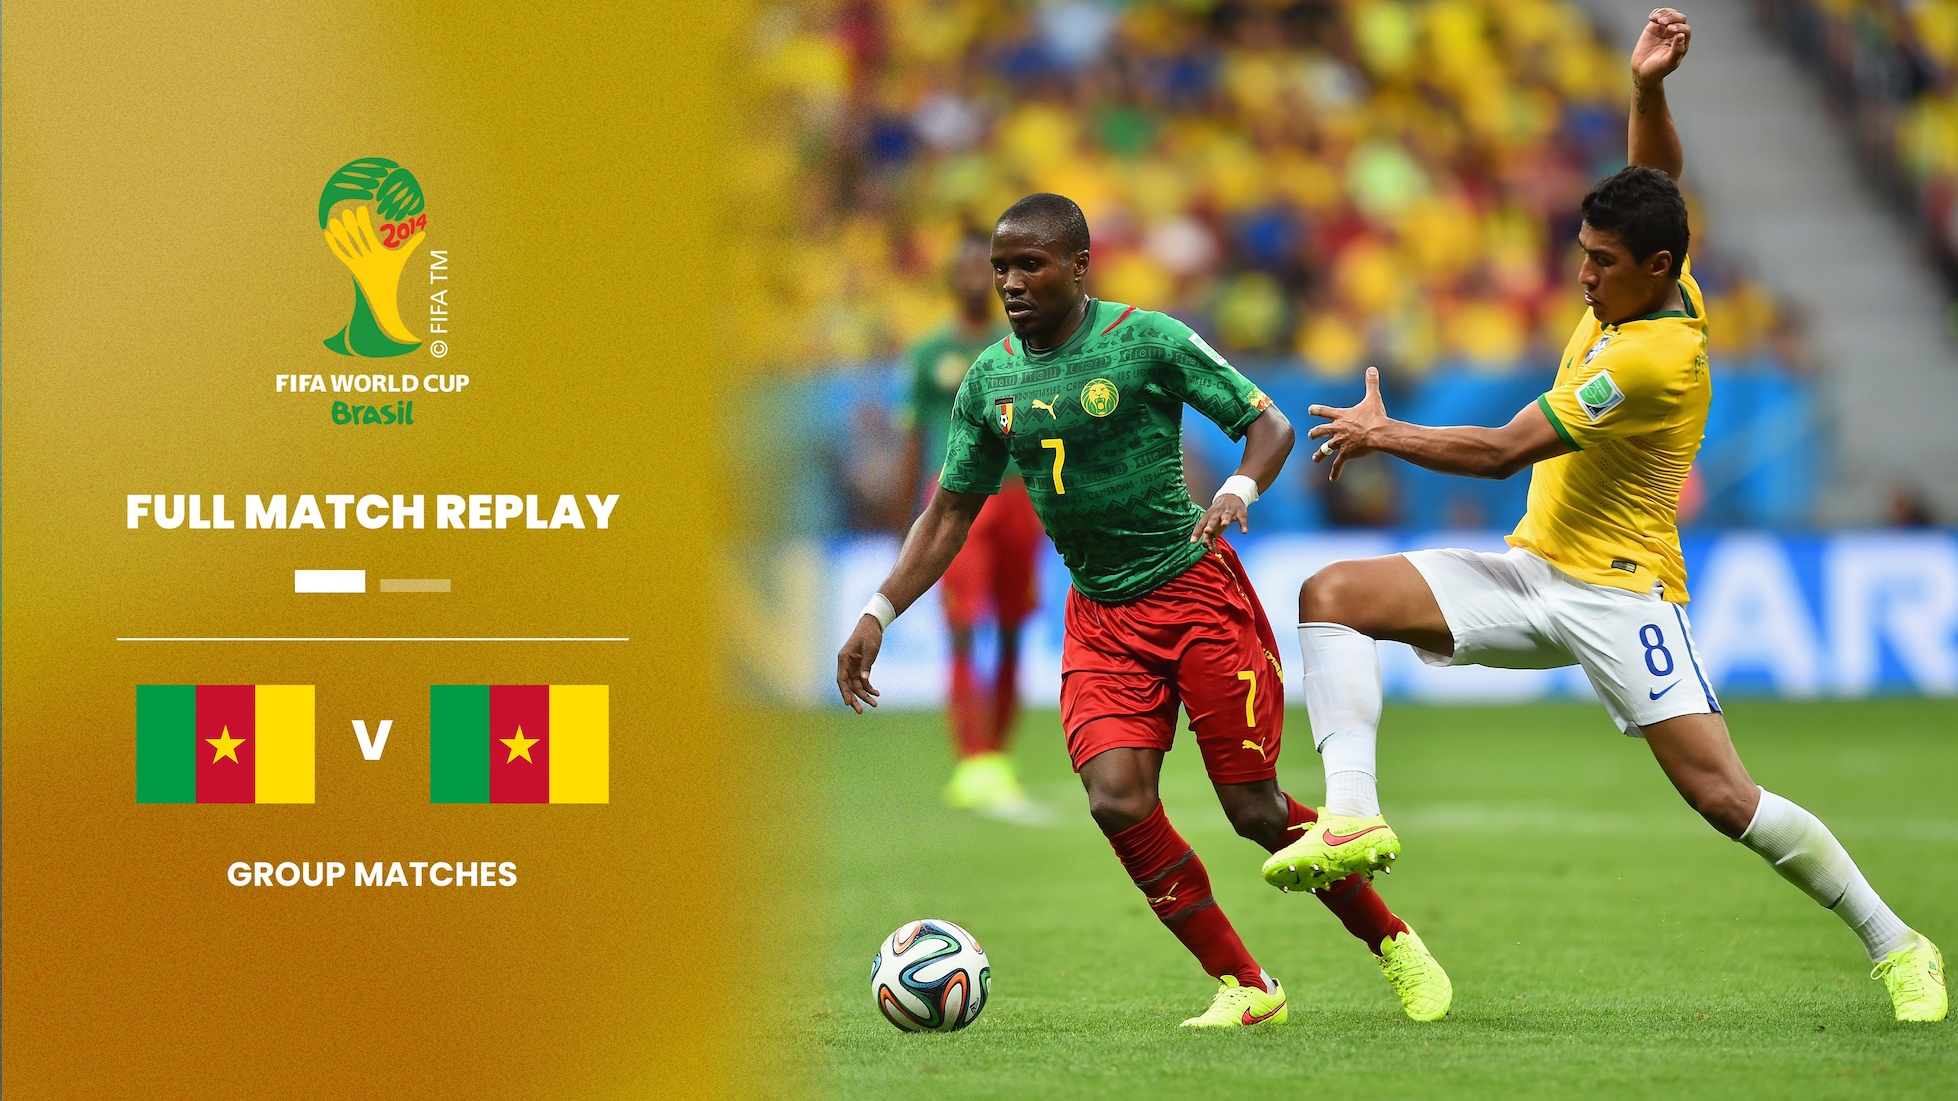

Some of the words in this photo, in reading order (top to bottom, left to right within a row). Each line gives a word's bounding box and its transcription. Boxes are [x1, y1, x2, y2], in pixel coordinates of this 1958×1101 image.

[1041, 438, 1065, 495] 7
[1638, 623, 1675, 677] 8
[1237, 670, 1257, 728] 7
